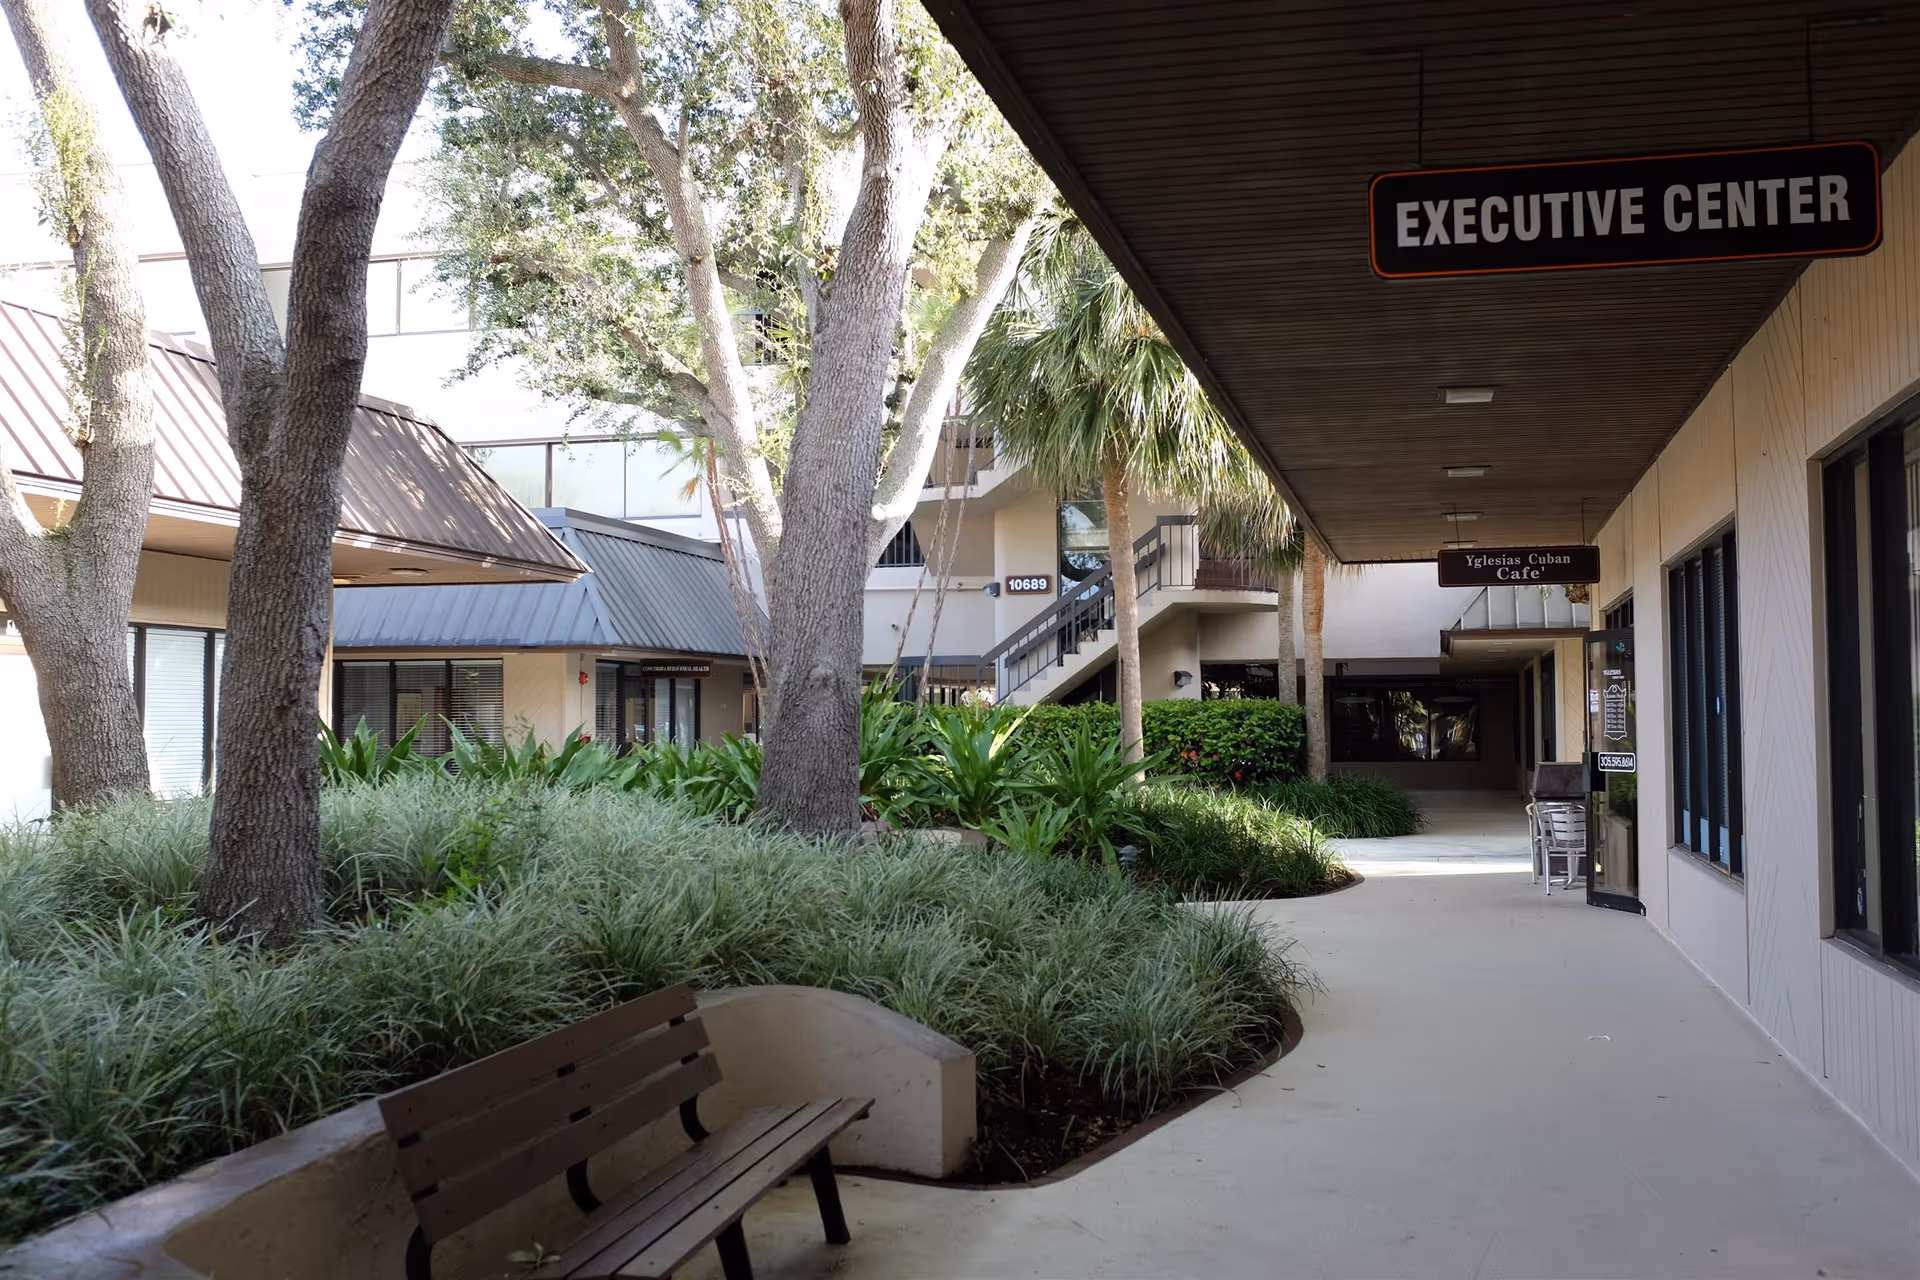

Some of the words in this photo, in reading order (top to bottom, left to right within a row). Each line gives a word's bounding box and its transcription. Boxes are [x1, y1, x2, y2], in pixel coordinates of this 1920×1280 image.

[1397, 188, 1645, 248] EXECUTIVE
[1663, 175, 1851, 232] CENTER
[1465, 554, 1521, 568] Yglesias
[1528, 553, 1571, 565] Cuban
[1008, 578, 1047, 591] 10689
